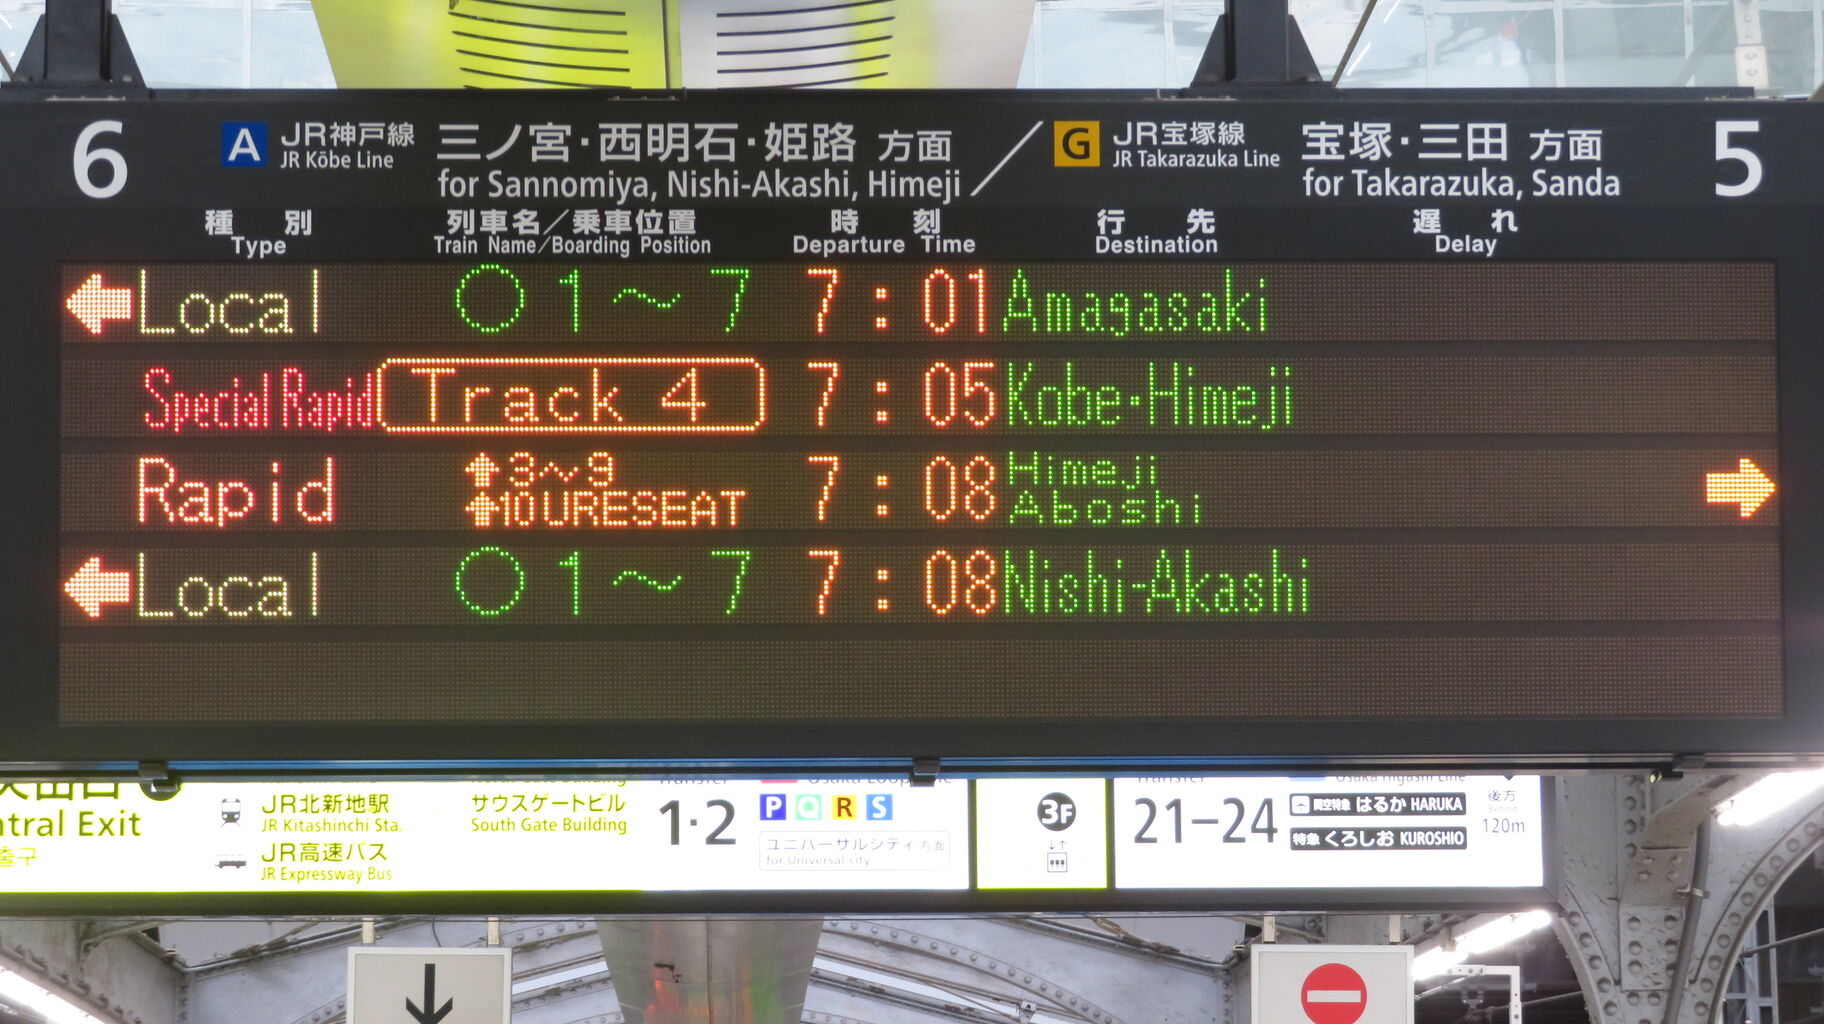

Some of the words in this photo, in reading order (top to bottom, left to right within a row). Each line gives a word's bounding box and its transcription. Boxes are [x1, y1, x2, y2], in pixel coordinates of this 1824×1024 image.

[228, 128, 261, 162] A
[281, 122, 415, 147] JR神戸線
[878, 129, 952, 162] 方面
[1062, 127, 1090, 160] G
[1113, 121, 1245, 146] JR宝塚線
[1301, 121, 1508, 162] 宝塚・三田
[1529, 129, 1603, 162] 方面
[72, 120, 128, 199] 6
[280, 152, 300, 169] JR
[306, 151, 352, 170] Kōbe
[357, 152, 394, 170] Line
[1112, 150, 1132, 168] JR
[1138, 149, 1238, 168] Takarazuka
[1244, 149, 1281, 168] Line
[1714, 120, 1763, 197] 5
[438, 168, 479, 198] for
[488, 169, 657, 205] Sannomiya,
[668, 168, 858, 202] Nishi-Akashi,
[868, 168, 961, 205] Himeji
[1302, 167, 1344, 197] for
[1352, 168, 1523, 201] Takarazuka,
[1532, 168, 1620, 197] Sanda
[231, 236, 287, 259] Type
[434, 235, 478, 254] Train
[640, 235, 711, 254] Position
[793, 235, 906, 257] Departure
[921, 235, 976, 253] Time
[1095, 236, 1218, 253] Destination
[1435, 235, 1497, 256] Delay
[140, 268, 319, 334] Local
[1002, 268, 1267, 337] Amagasaki
[144, 367, 270, 433] Special
[283, 367, 373, 432] Rapid
[411, 366, 624, 423] Track
[660, 366, 707, 423] 4
[1008, 450, 1159, 489] Himeji
[137, 456, 336, 528] Rapid
[1008, 489, 1202, 525] Aboshi
[138, 551, 317, 617] Local
[1003, 548, 1311, 614] Nishi-Akashi
[261, 794, 389, 814] JR北新地駅
[471, 794, 626, 813] サウスゲートビル
[765, 796, 782, 818] P
[798, 796, 820, 819] Q
[837, 797, 853, 818] R
[871, 796, 887, 818] S
[1041, 799, 1073, 825] 3F
[1356, 796, 1407, 813] はるか
[1410, 796, 1464, 812] HARUKA
[79, 809, 141, 837] Exit
[261, 818, 278, 832] JR
[283, 818, 369, 832] Kitashinchi
[471, 817, 516, 832] South
[521, 817, 558, 832] Gate
[562, 817, 627, 835] Building
[1482, 817, 1526, 834] 120m
[1292, 832, 1321, 846] 特急
[1324, 830, 1395, 847] くろしお
[1399, 830, 1465, 846] KUROSHIO
[261, 842, 388, 862] JR高速バス
[260, 867, 277, 881] JR
[281, 867, 363, 884] Expressway
[368, 867, 393, 881] Bus
